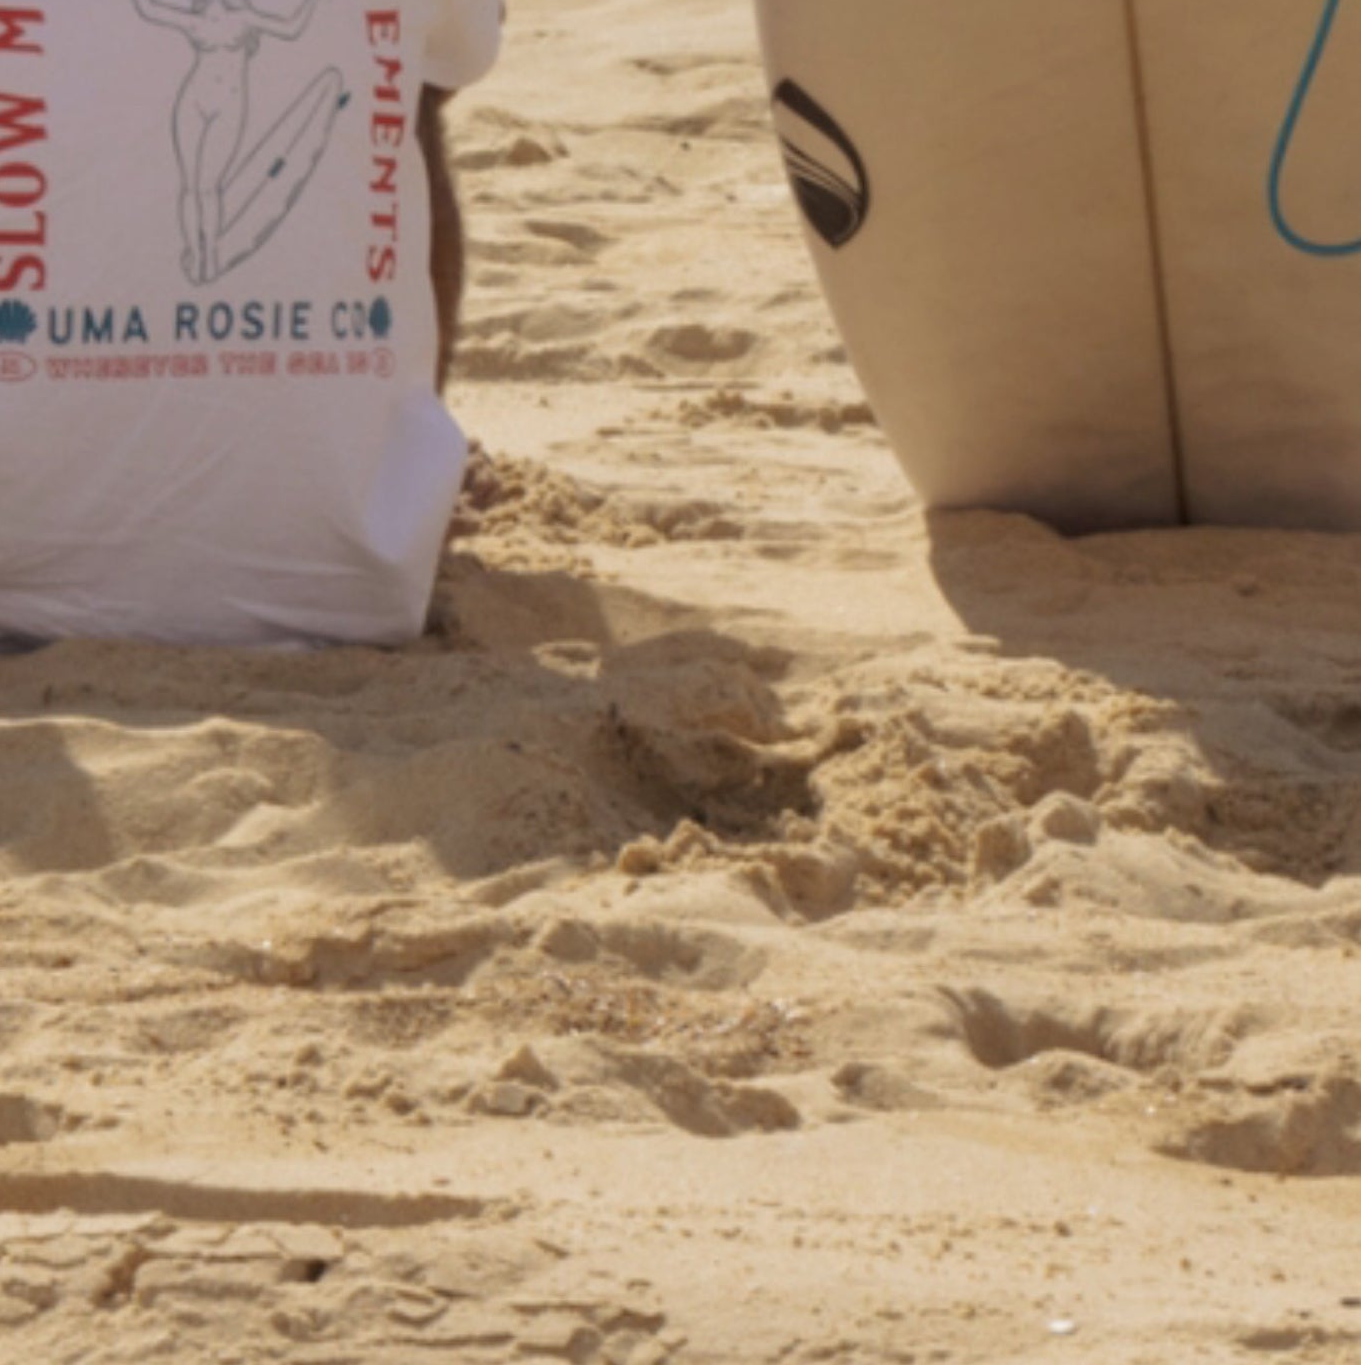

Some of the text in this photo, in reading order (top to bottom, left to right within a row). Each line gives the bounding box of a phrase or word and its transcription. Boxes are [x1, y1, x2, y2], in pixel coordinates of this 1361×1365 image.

[47, 300, 367, 346] UMA ROSIE CO
